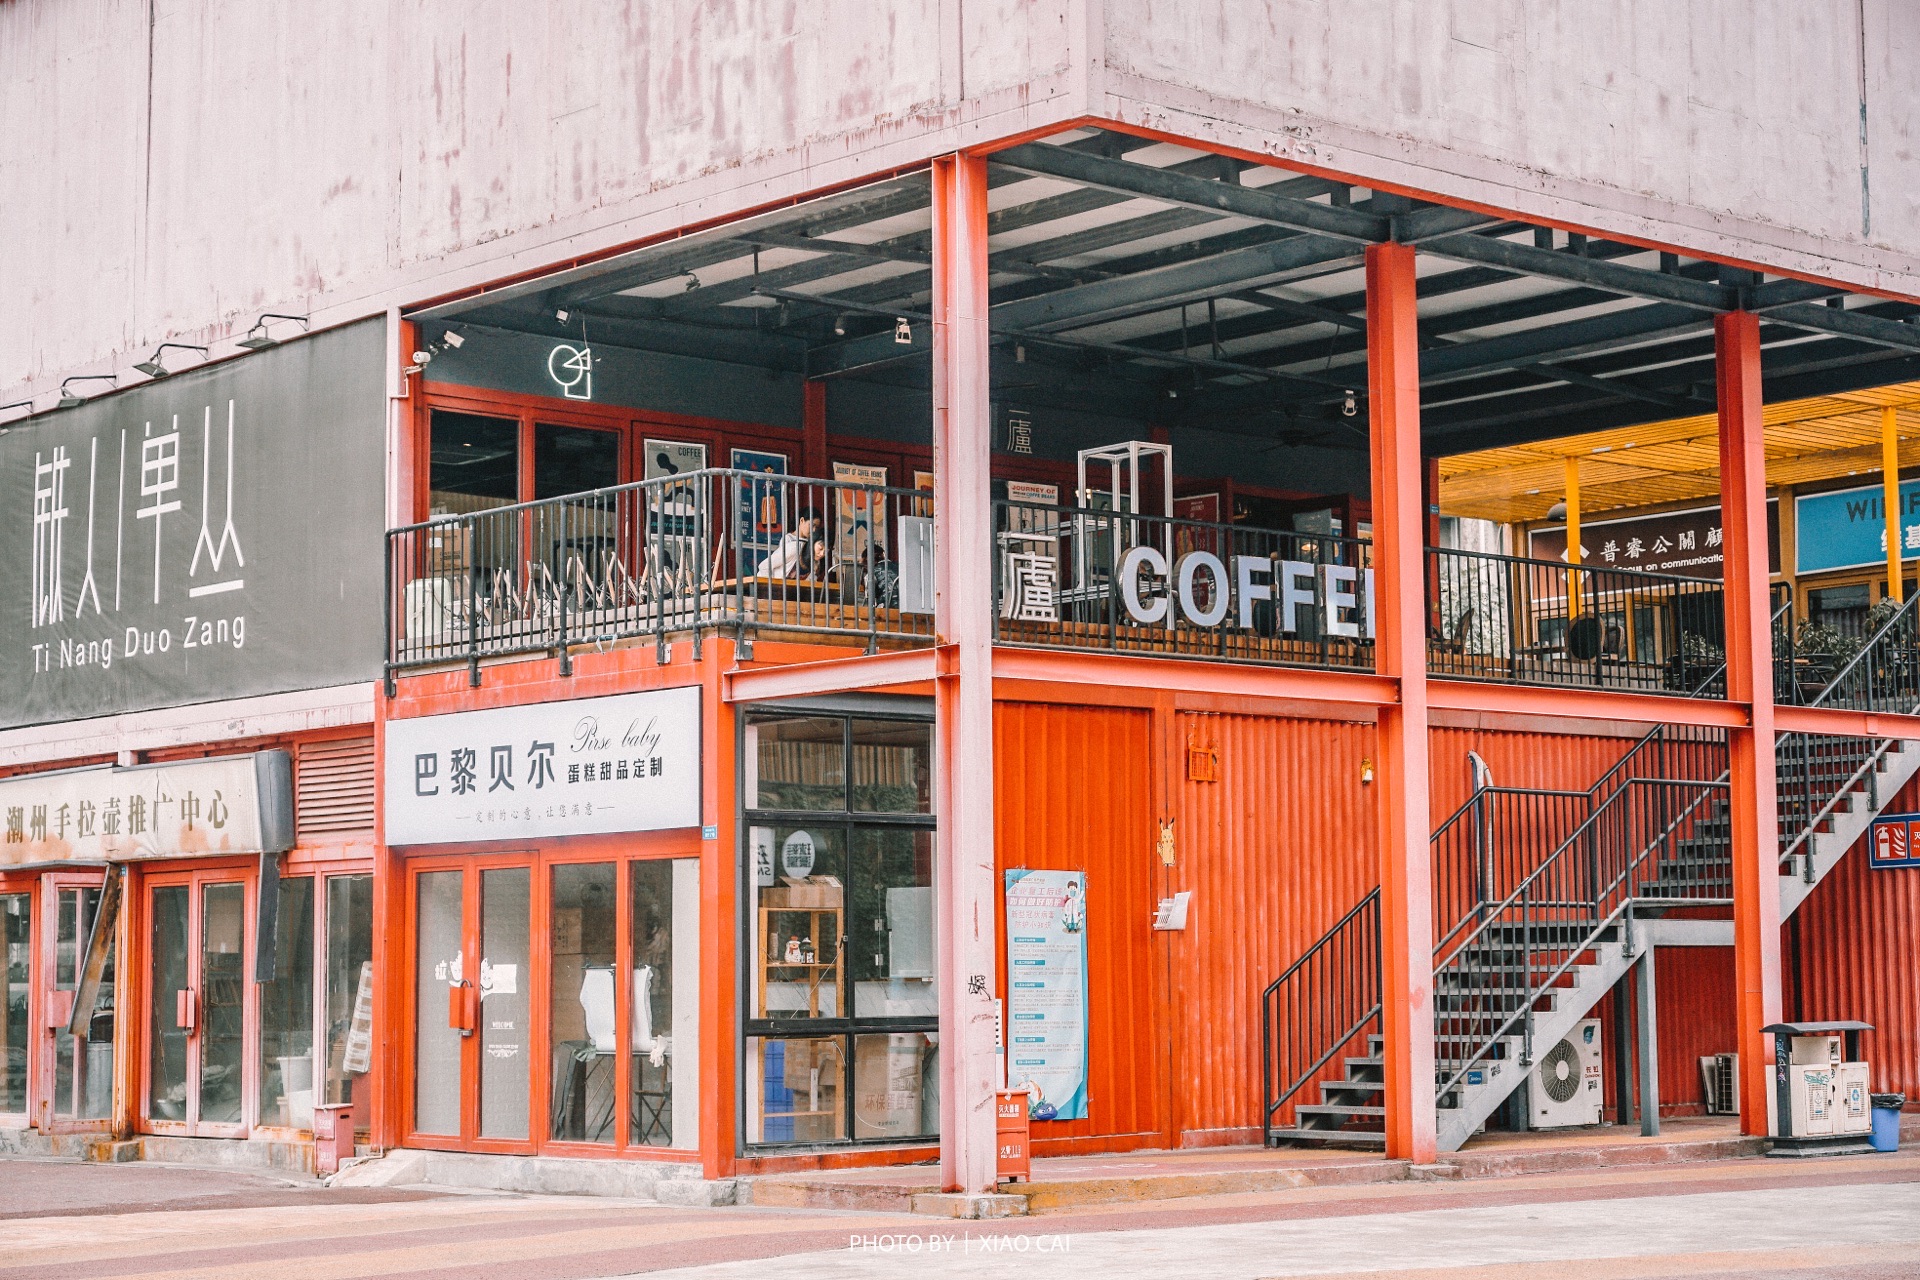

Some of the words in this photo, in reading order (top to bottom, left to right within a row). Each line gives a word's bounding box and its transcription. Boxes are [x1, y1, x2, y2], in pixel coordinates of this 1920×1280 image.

[1011, 485, 1044, 494] JOURNEY
[1645, 562, 1658, 571] on
[32, 643, 49, 673] Ti
[60, 636, 112, 669] Nang
[125, 626, 171, 657] Duo
[184, 615, 244, 649] Zang
[621, 715, 661, 758] baby
[414, 739, 555, 797] 巴黎贝尔
[567, 756, 662, 784] 蛋糕甜品定制
[6, 789, 229, 844] 潮州手拉壶推广中心
